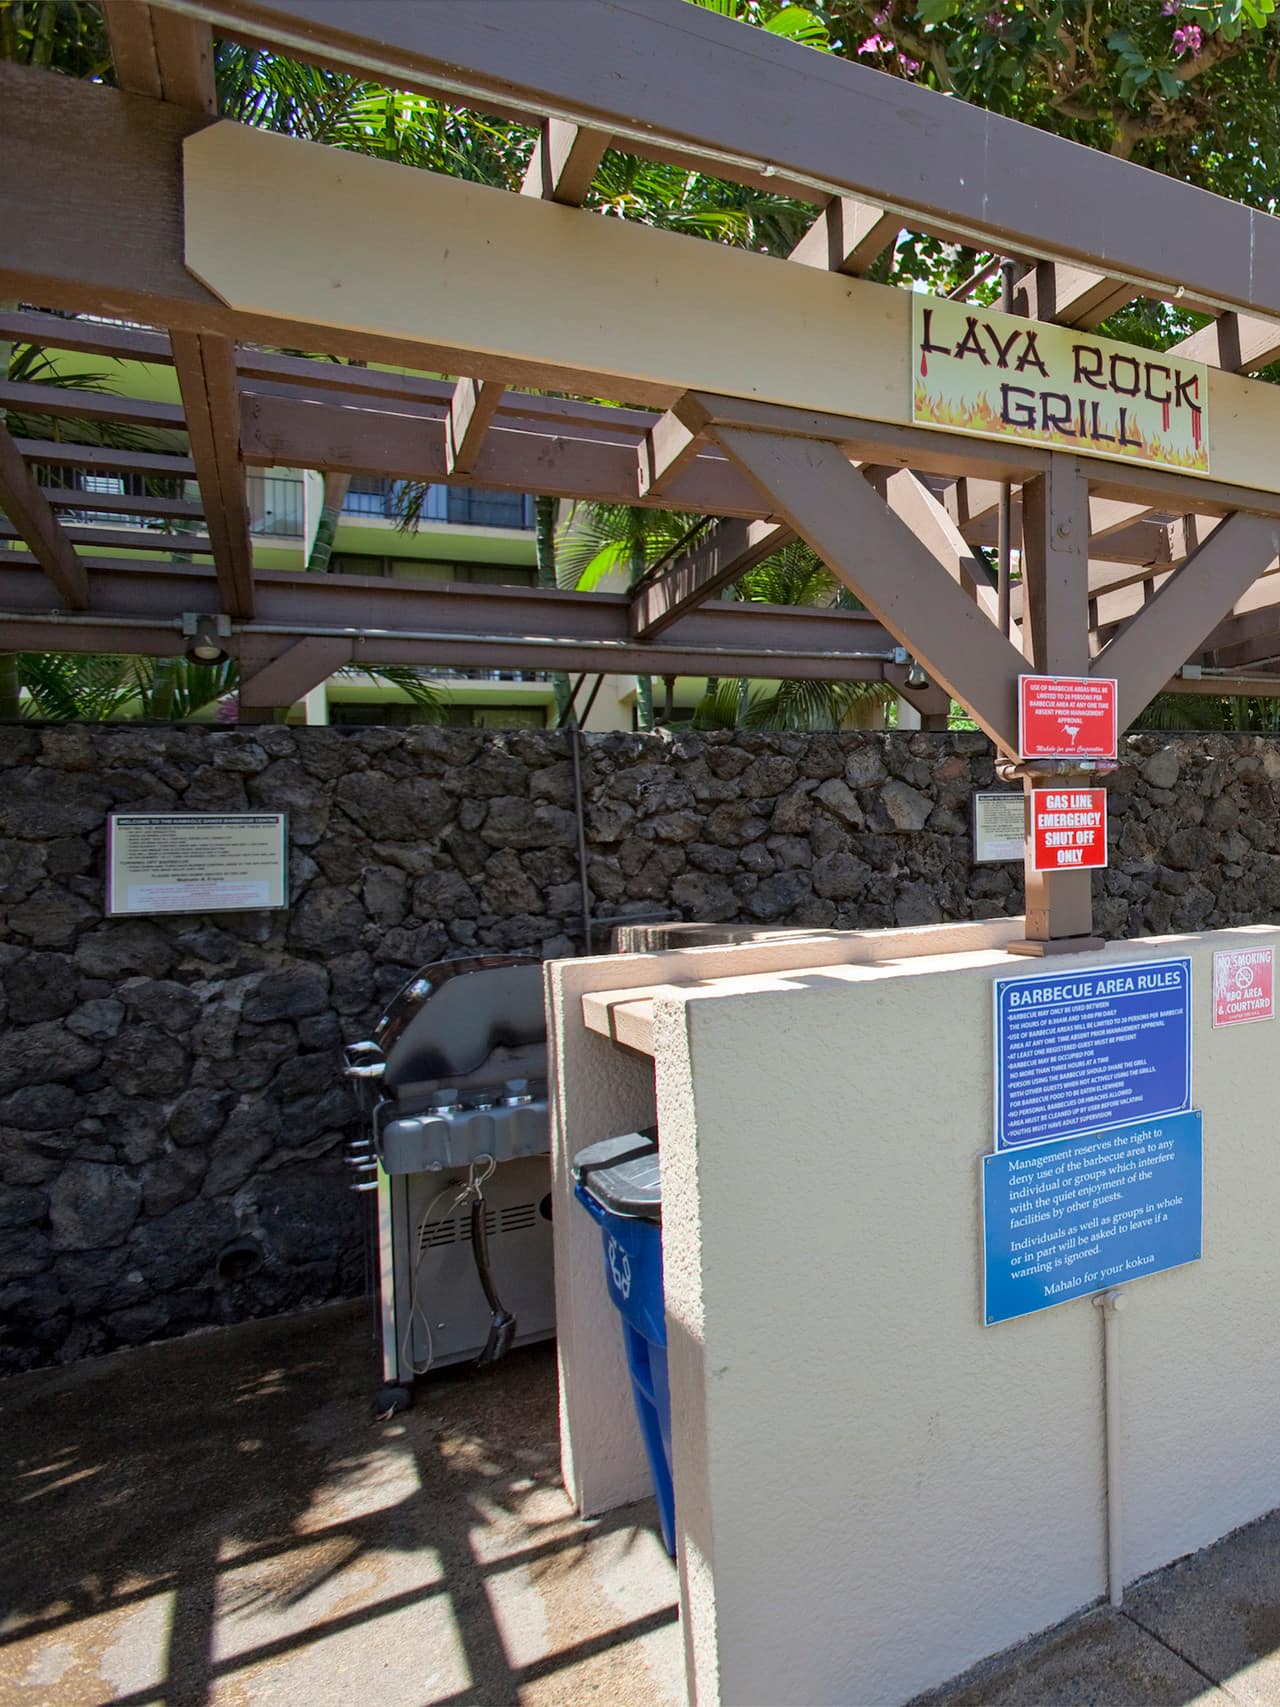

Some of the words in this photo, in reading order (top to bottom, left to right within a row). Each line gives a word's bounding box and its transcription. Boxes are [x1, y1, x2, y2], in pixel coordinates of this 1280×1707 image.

[1073, 344, 1201, 412] ROCK
[1000, 382, 1142, 447] GRILL
[1038, 813, 1100, 826] EMERGENCY
[1046, 796, 1068, 809] GAS
[1070, 795, 1092, 808] LINE
[1045, 831, 1073, 845] SHUT
[1076, 831, 1094, 844] OFF
[1057, 850, 1083, 863] ONLY
[1217, 956, 1230, 968] NO
[1231, 951, 1271, 967] SMOKING
[1010, 982, 1092, 1006] BARBECUE
[1095, 977, 1134, 995] AREA
[1138, 971, 1180, 989] RULES
[1218, 1005, 1224, 1014] &
[1226, 997, 1270, 1013] COURTYARD
[1244, 987, 1262, 998] AREA
[1008, 1148, 1072, 1171] Management
[1074, 1141, 1111, 1156] reserves
[1113, 1136, 1128, 1146] the
[1129, 1130, 1151, 1144] right
[1153, 1129, 1162, 1137] to
[1008, 1173, 1034, 1185] deny
[1036, 1169, 1053, 1179] use
[1055, 1162, 1064, 1174] of
[1066, 1161, 1081, 1171] the
[1083, 1151, 1125, 1167] barbecue
[1126, 1146, 1145, 1157] area
[1147, 1144, 1156, 1152] to
[1158, 1140, 1173, 1149] any
[1009, 1178, 1059, 1200] individual
[1062, 1178, 1072, 1186] or
[1074, 1169, 1106, 1186] groups
[1108, 1160, 1136, 1174] which
[1138, 1152, 1174, 1167] interfere
[1009, 1200, 1032, 1213] with
[1035, 1197, 1050, 1208] the
[1052, 1189, 1076, 1205] quiet
[1077, 1176, 1125, 1196] enjoyment
[1127, 1172, 1136, 1183] of
[1138, 1170, 1152, 1180] the
[1010, 1211, 1050, 1229] facilities
[1052, 1207, 1064, 1218] by
[1066, 1200, 1090, 1213] other
[1092, 1192, 1122, 1208] guests.
[1011, 1228, 1066, 1251] Individuals
[1067, 1227, 1077, 1235] as
[1079, 1217, 1098, 1230] well
[1100, 1217, 1110, 1225] as
[1112, 1207, 1144, 1224] groups
[1145, 1203, 1154, 1212] in
[1156, 1195, 1182, 1209] whole
[1010, 1255, 1021, 1265] or
[1024, 1252, 1034, 1262] in
[1036, 1245, 1056, 1261] part
[1058, 1237, 1075, 1251] will
[1077, 1236, 1088, 1245] be
[1090, 1225, 1116, 1241] asked
[1119, 1225, 1127, 1233] to
[1130, 1218, 1152, 1230] leave
[1154, 1213, 1160, 1223] if
[1011, 1260, 1052, 1279] warning
[1054, 1258, 1062, 1266] is
[1044, 1276, 1081, 1296] Mahalo
[1084, 1271, 1097, 1282] for
[1100, 1263, 1123, 1280] your
[1125, 1254, 1154, 1269] kokua
